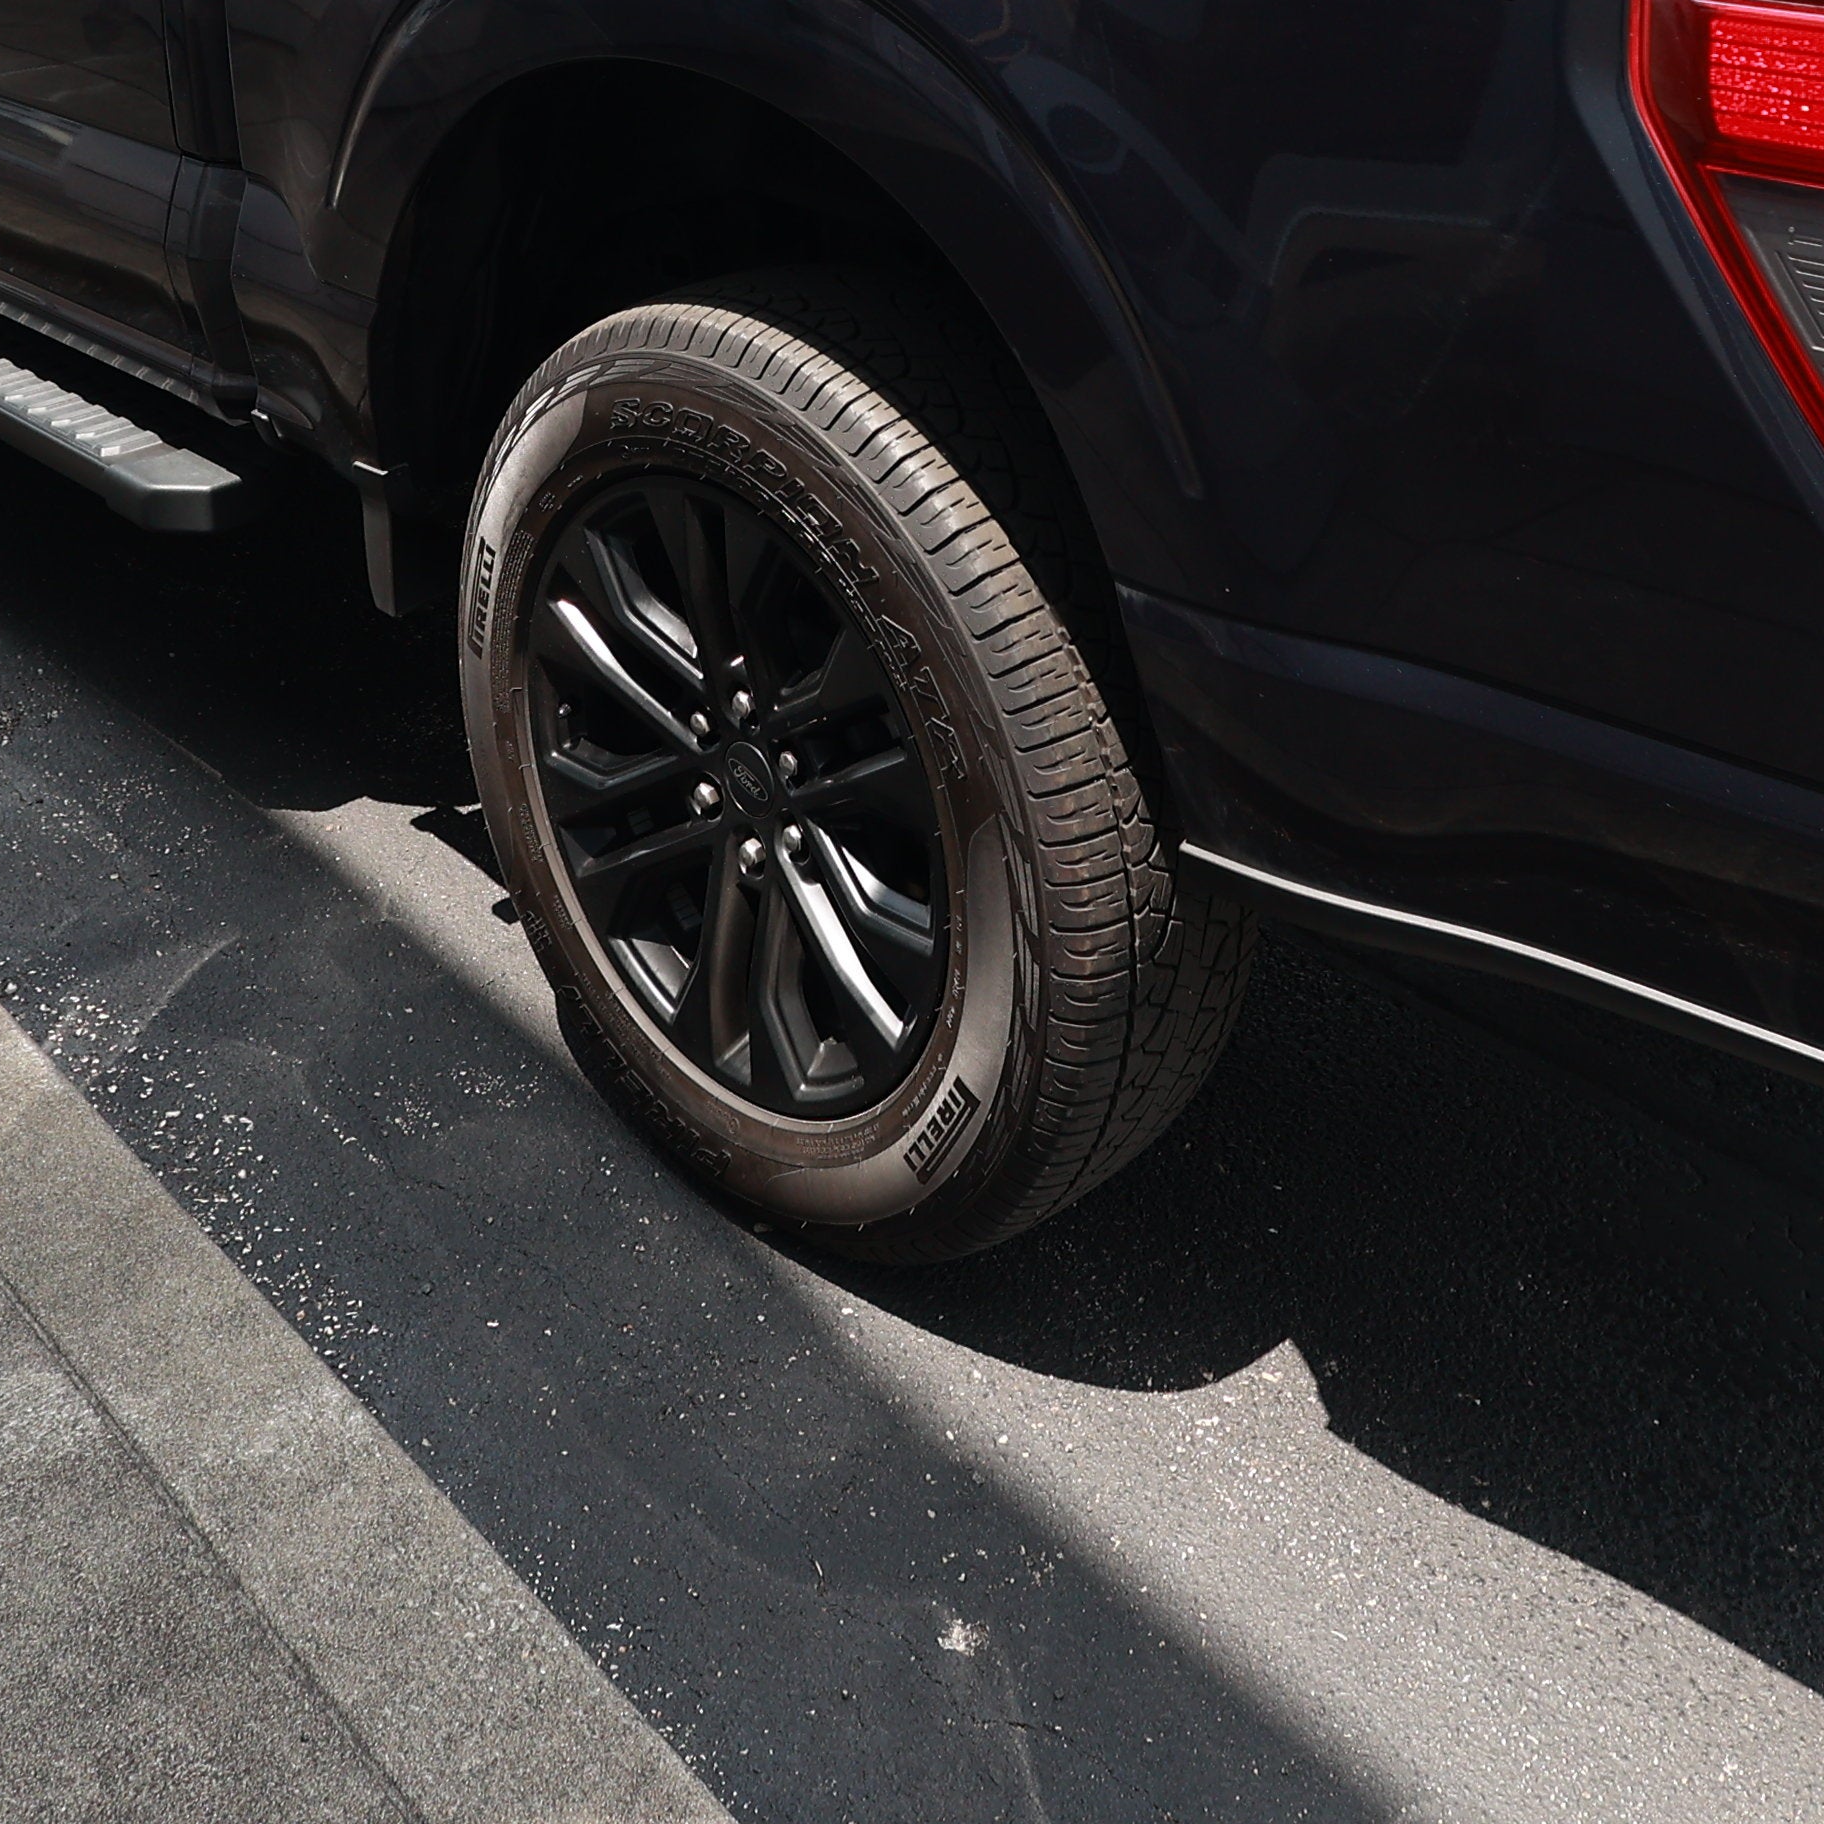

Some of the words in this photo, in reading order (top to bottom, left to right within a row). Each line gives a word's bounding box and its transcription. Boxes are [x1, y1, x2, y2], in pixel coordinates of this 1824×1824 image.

[609, 397, 880, 588] SCORPION
[467, 535, 497, 661] PIRELLI
[902, 1074, 982, 1186] PIRELLI
